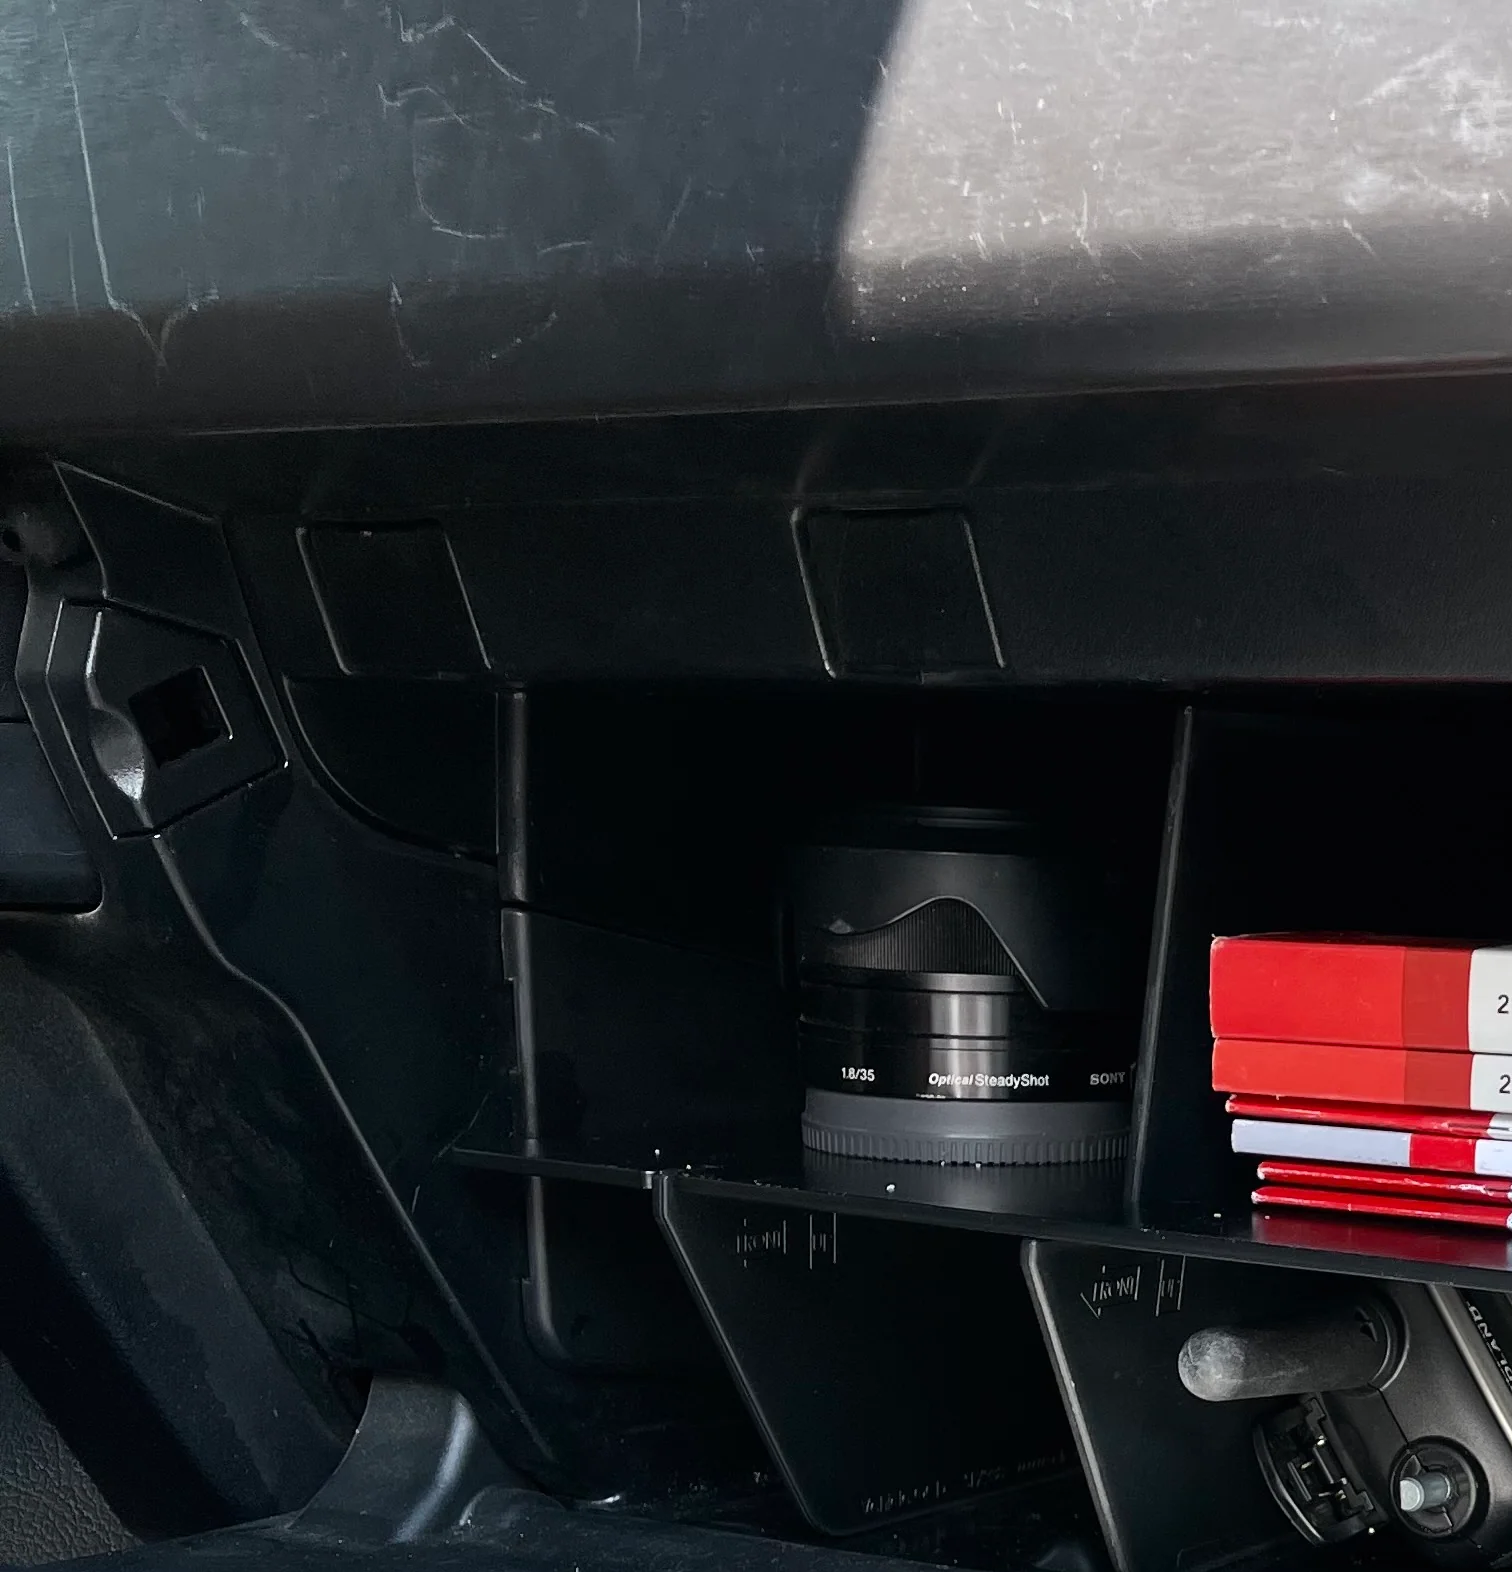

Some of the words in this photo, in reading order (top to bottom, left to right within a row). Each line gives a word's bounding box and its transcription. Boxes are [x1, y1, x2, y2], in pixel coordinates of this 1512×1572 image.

[928, 1072, 974, 1088] Optical
[974, 1072, 1050, 1090] SteadyShot
[1089, 1071, 1126, 1086] SONY
